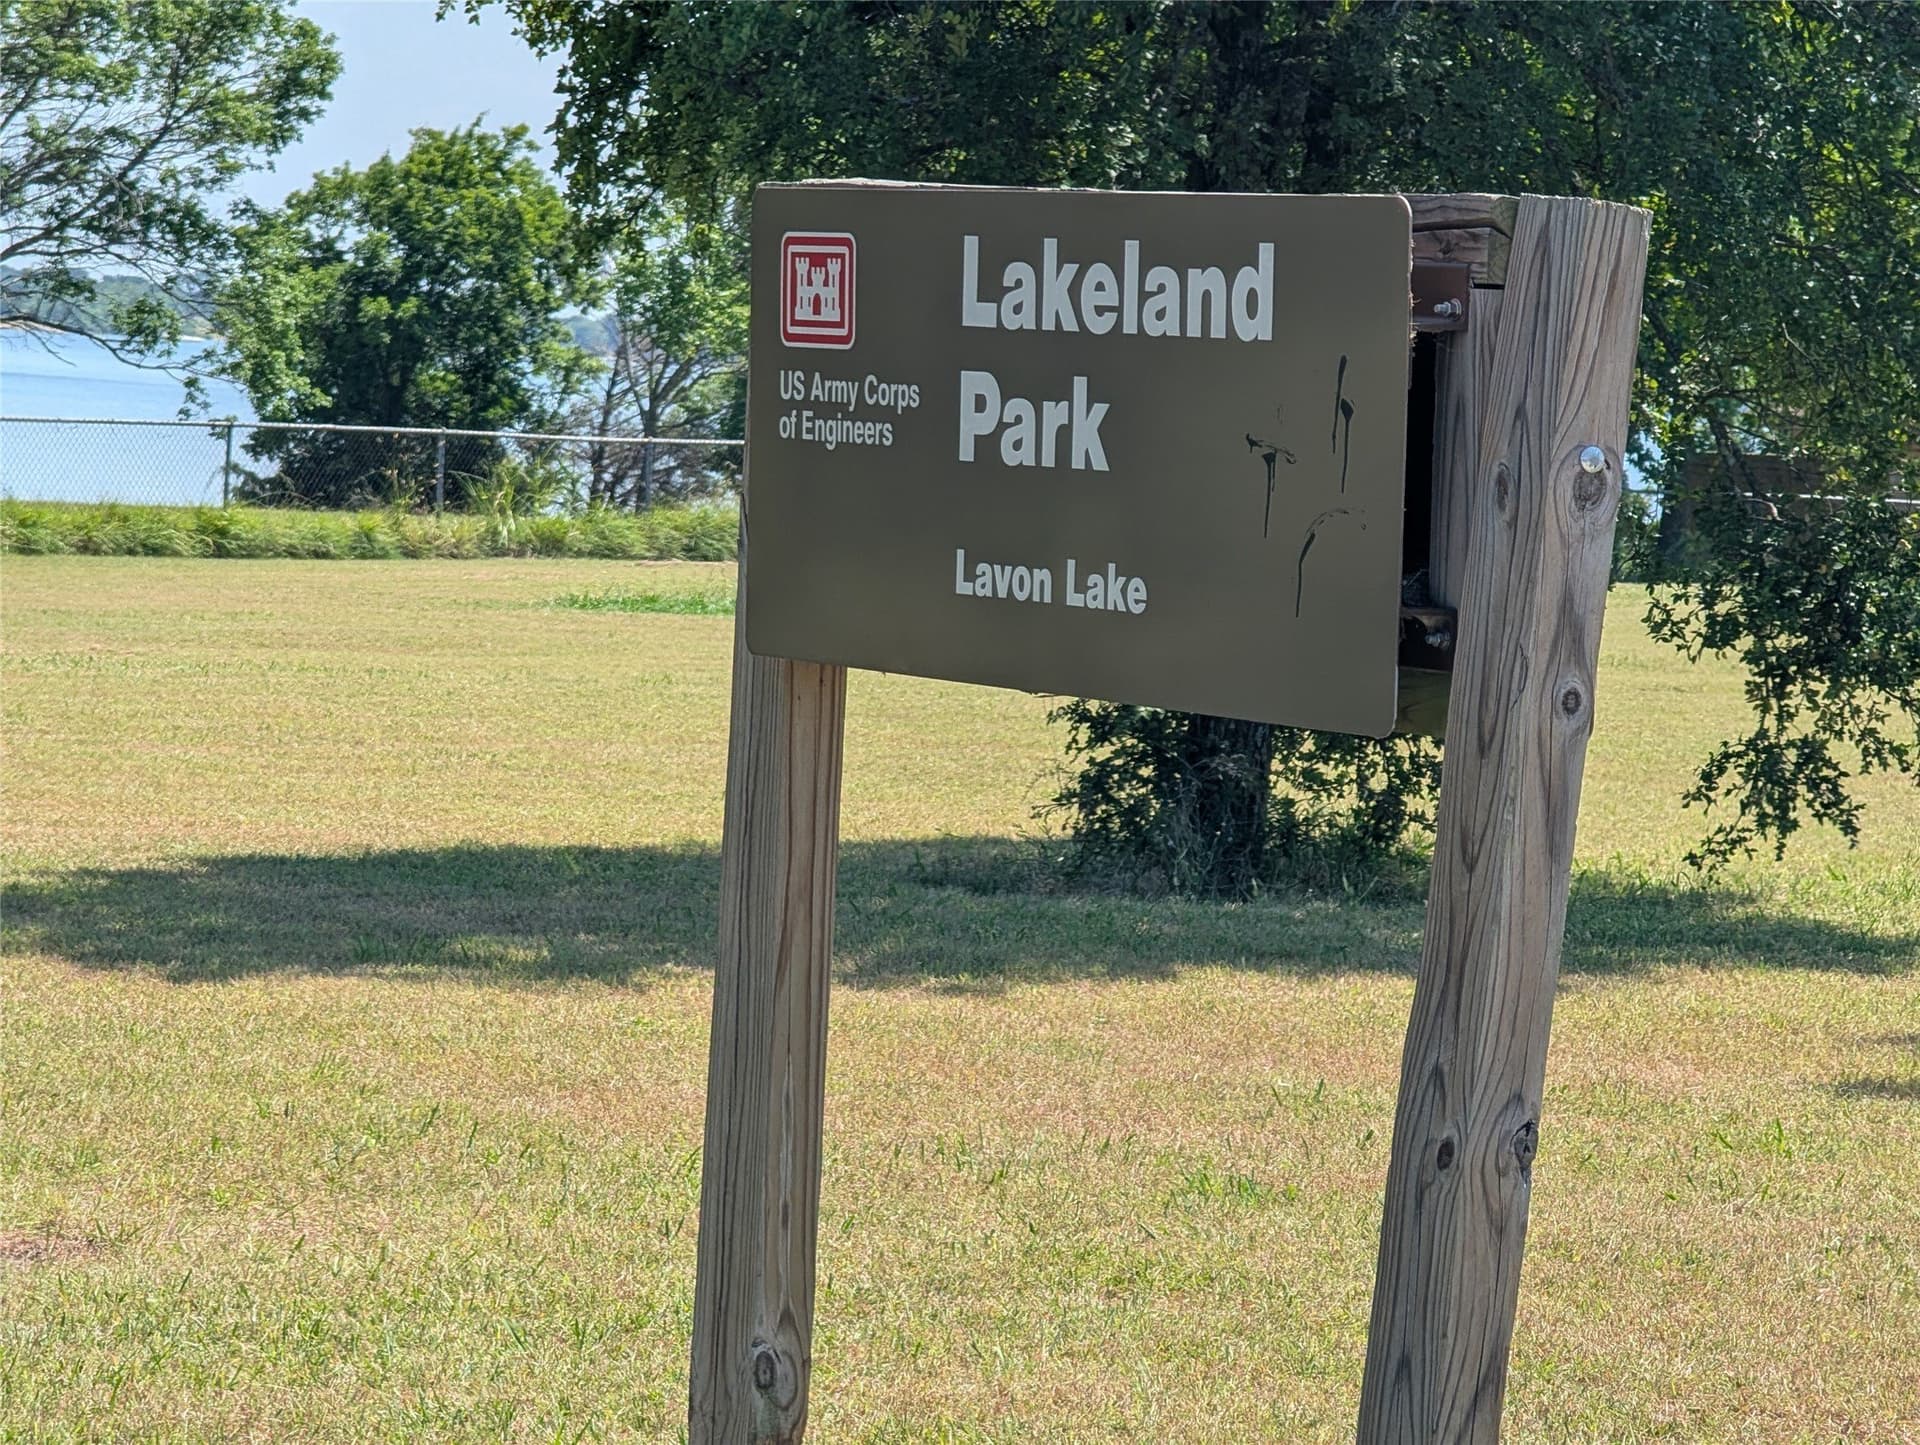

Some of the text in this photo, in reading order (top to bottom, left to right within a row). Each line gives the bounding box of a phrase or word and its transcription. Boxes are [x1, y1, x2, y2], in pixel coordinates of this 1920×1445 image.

[962, 235, 1274, 342] Lakeland
[780, 370, 920, 415] US Army Corps
[959, 370, 1110, 471] Park
[779, 409, 893, 450] of Engineers
[955, 549, 1147, 615] Lavon Lake
